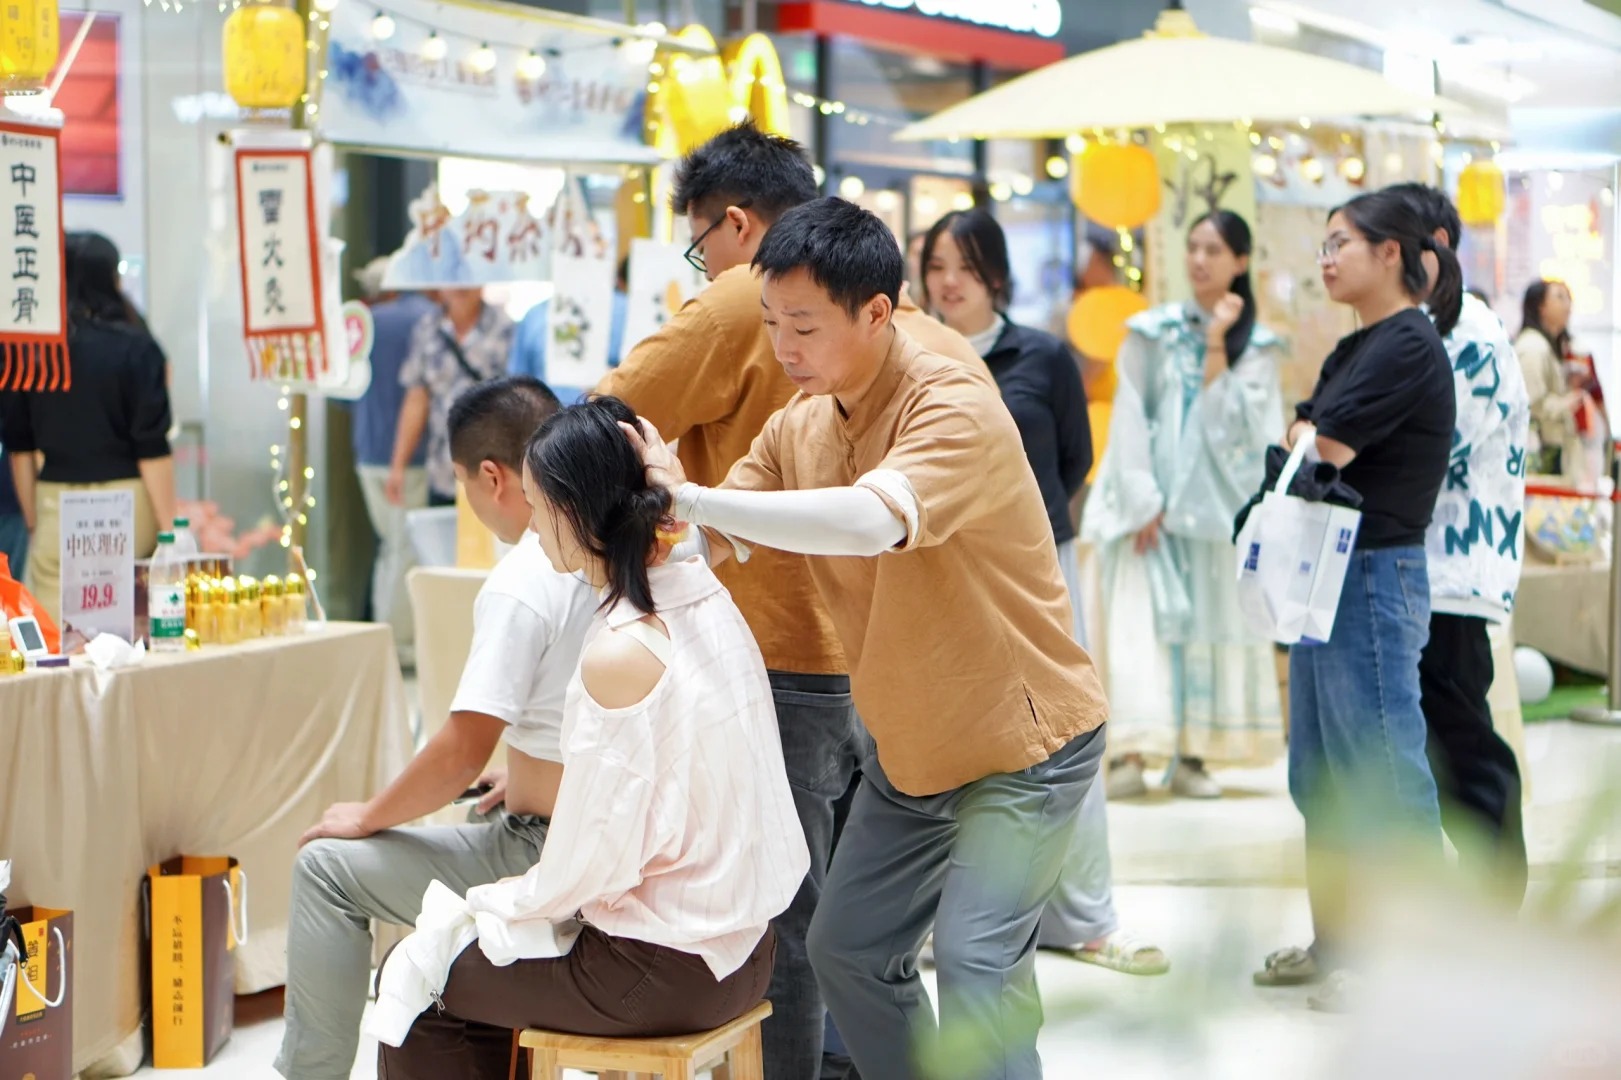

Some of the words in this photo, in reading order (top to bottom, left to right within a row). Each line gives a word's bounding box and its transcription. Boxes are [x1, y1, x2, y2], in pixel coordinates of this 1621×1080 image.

[10, 160, 39, 324] 中医正骨
[67, 532, 127, 558] 中医理疗
